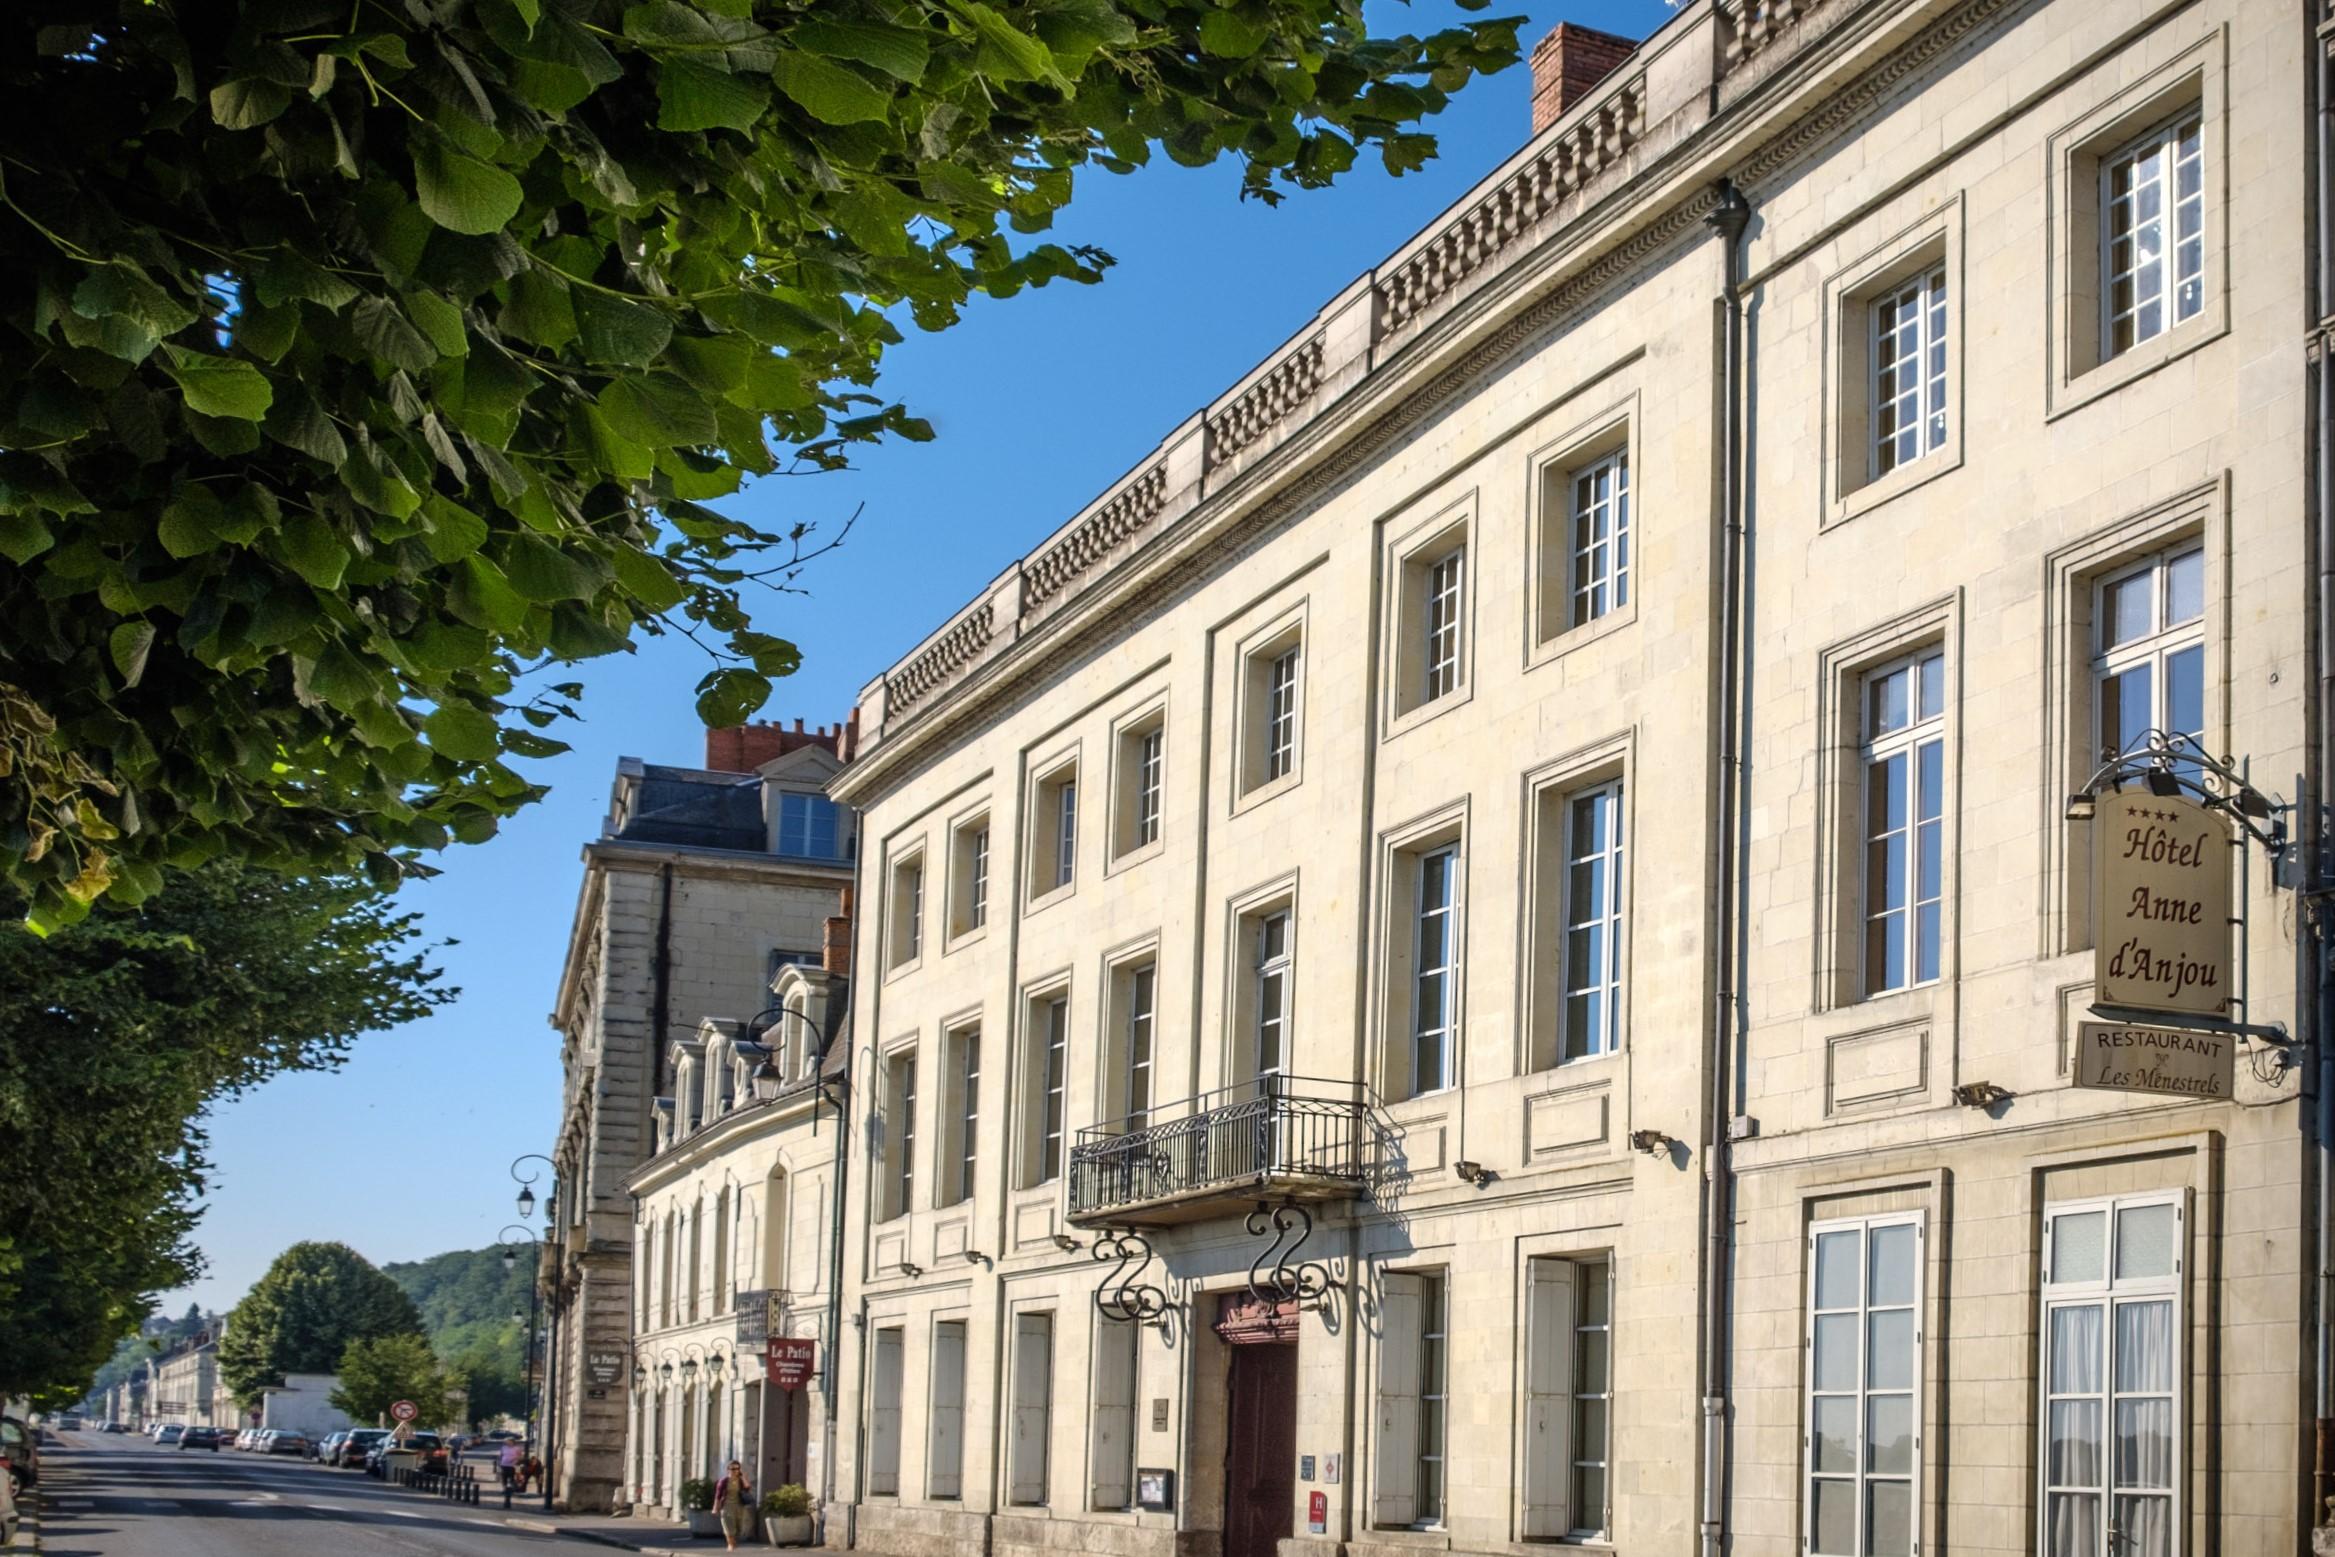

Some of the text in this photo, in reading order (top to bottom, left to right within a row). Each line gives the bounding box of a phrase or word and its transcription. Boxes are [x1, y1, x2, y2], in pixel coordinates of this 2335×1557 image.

[2123, 825, 2208, 868] Hôtel
[2126, 886, 2202, 925] Anne
[2109, 937, 2217, 998] d'Anjou
[2097, 1031, 2223, 1058] RESTAURANT
[2096, 1065, 2220, 1095] Les Ménestrels
[590, 1354, 599, 1364] Le
[771, 1345, 783, 1358] Le
[1315, 1496, 1323, 1509] H
